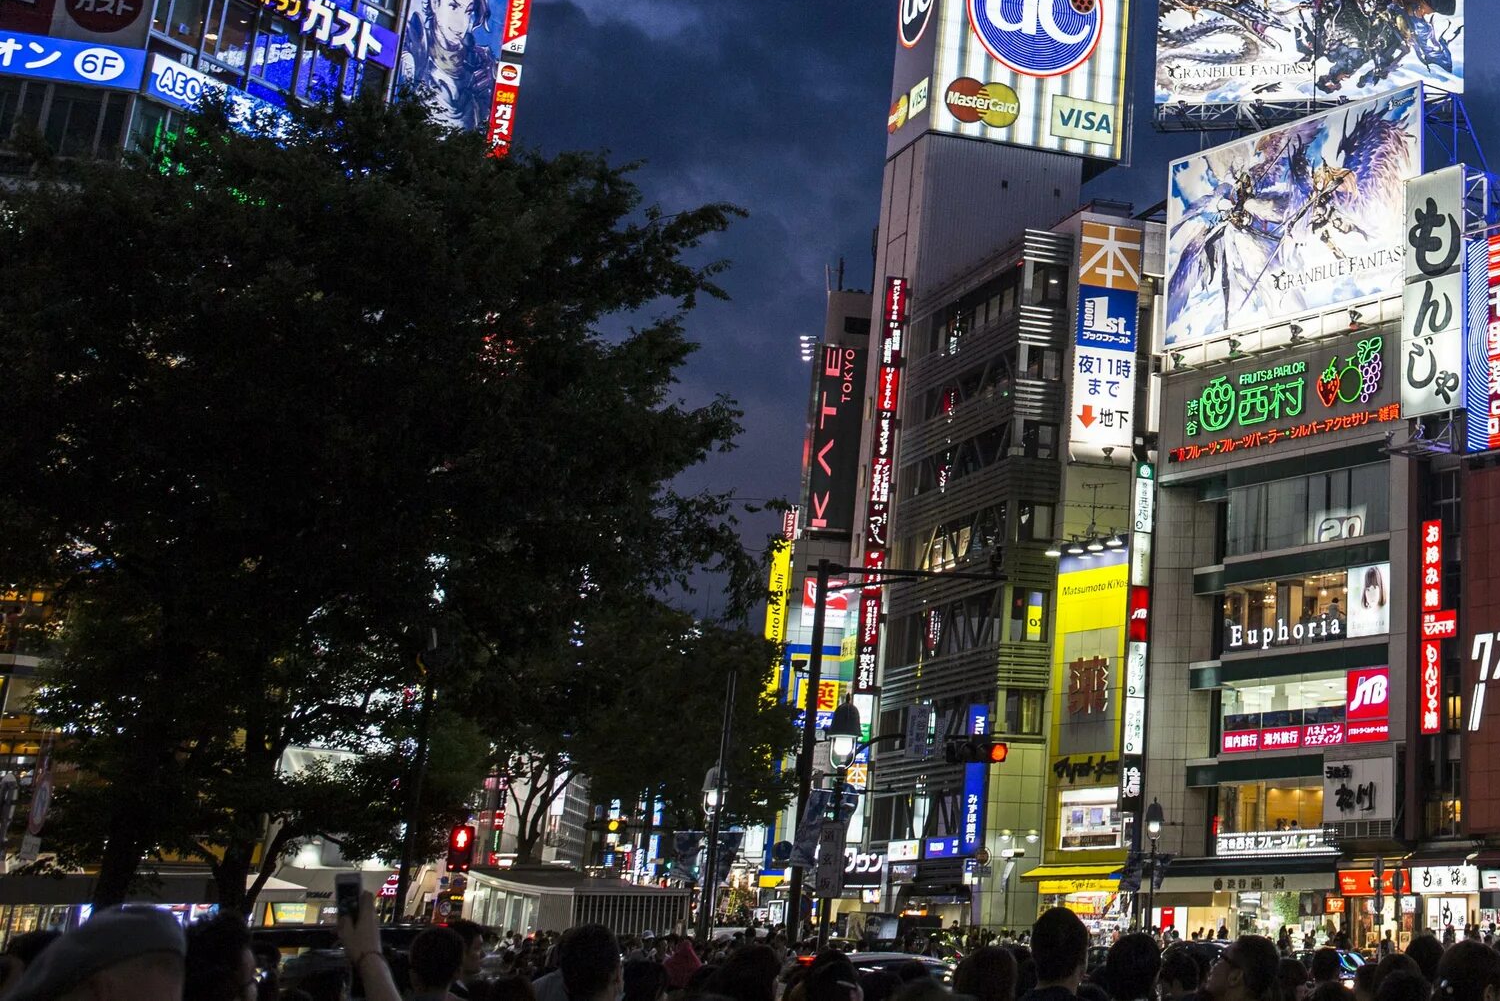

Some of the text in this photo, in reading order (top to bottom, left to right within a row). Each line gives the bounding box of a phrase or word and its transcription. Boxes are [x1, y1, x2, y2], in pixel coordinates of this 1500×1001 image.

[80, 53, 119, 76] 6F
[1170, 60, 1315, 81] GRANBLUE FANTASY
[946, 88, 1018, 116] MasterCard
[1058, 107, 1112, 135] VISA
[1407, 196, 1461, 405] もんじゃ
[1083, 299, 1095, 329] BOOK
[1083, 331, 1131, 344] ブックファースト
[840, 348, 856, 403] TOKYO
[1078, 354, 1131, 379] 夜11時
[1240, 361, 1305, 385] FRUITS&PARLOR
[1088, 378, 1120, 398] まで
[1238, 378, 1304, 426] 西村
[1099, 407, 1129, 429] 地下
[1186, 400, 1198, 436] 渋谷
[1062, 581, 1106, 597] Matsumoto
[1131, 607, 1148, 620] JTB
[1230, 613, 1340, 649] Euphoria
[1349, 674, 1388, 712] JTB
[1224, 734, 1258, 749] 国内旅行
[1264, 730, 1298, 746] 海外旅行
[1304, 732, 1342, 746] ウエディング
[1307, 724, 1340, 735] ハネムーン
[965, 793, 978, 844] みずほ銀行
